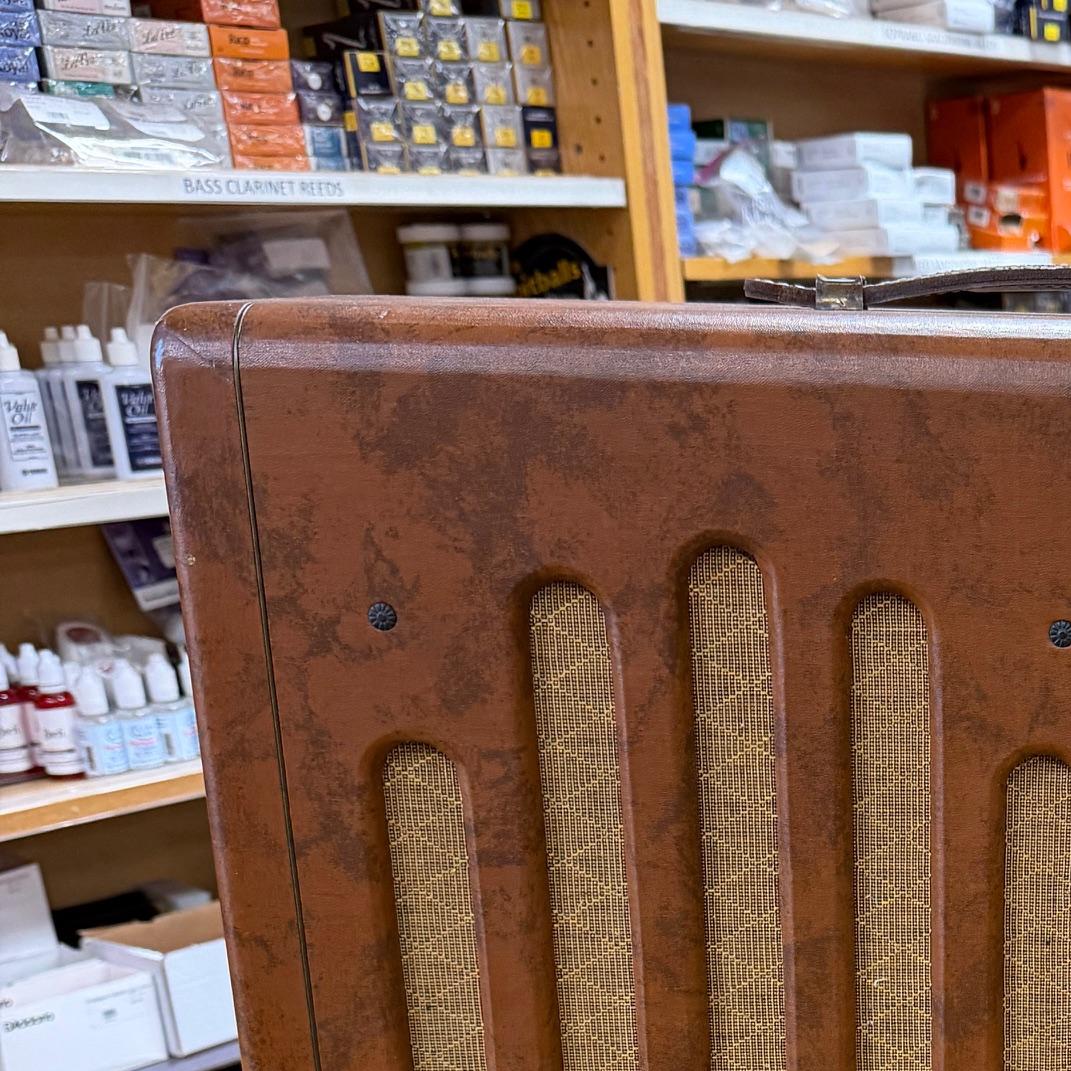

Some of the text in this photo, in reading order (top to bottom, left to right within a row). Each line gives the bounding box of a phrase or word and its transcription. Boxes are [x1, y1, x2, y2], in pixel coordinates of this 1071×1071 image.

[183, 178, 345, 197] BASS CLARINET REEDS
[11, 412, 33, 425] Oil
